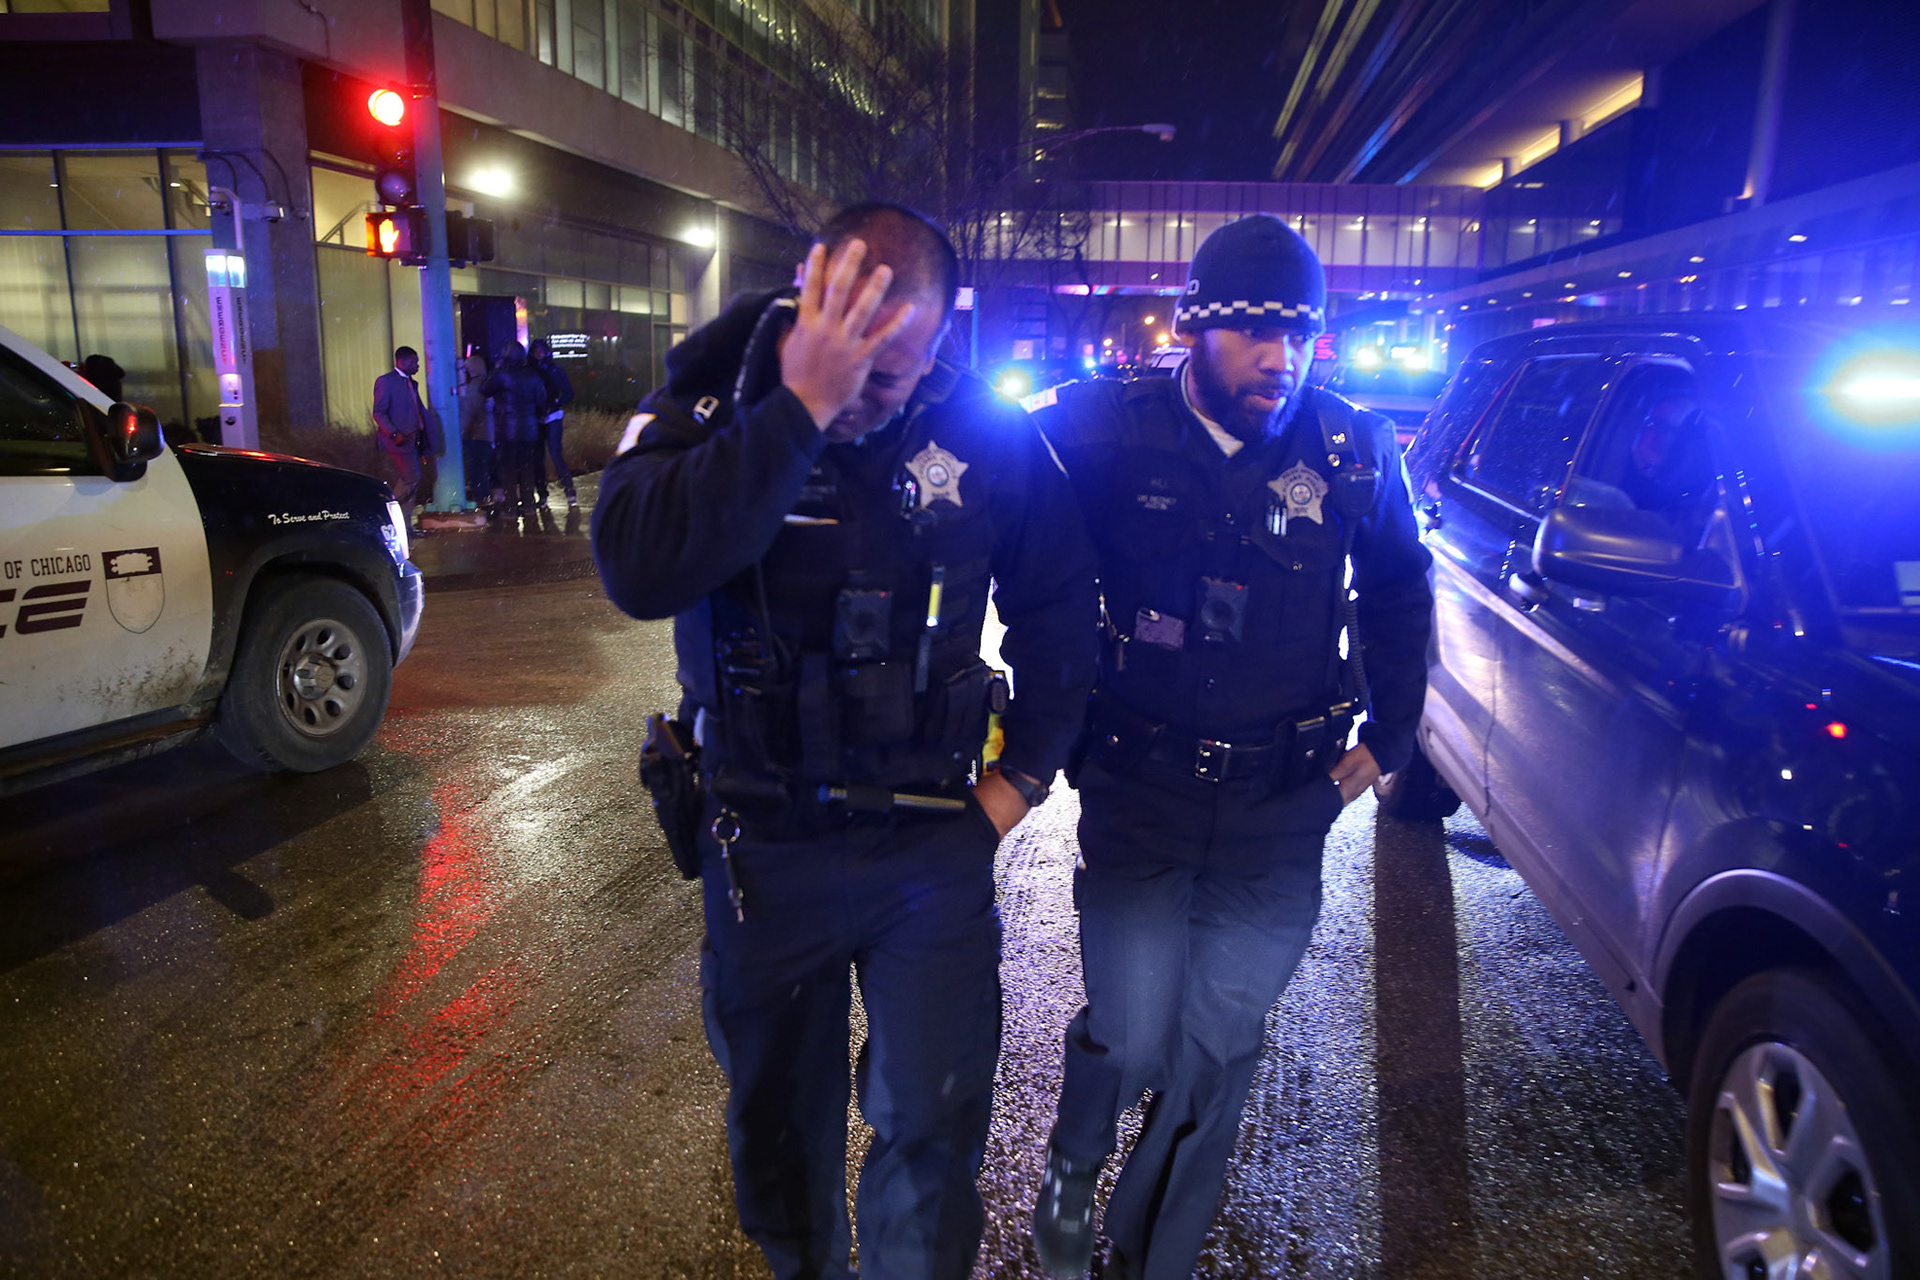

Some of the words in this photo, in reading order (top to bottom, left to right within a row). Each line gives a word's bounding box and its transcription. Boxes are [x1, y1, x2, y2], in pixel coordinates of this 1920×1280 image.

[268, 514, 282, 525] To
[282, 513, 307, 524] Serve
[307, 512, 323, 521] and
[321, 510, 350, 520] Protect
[4, 560, 22, 580] OF
[31, 554, 92, 577] CHICAGO
